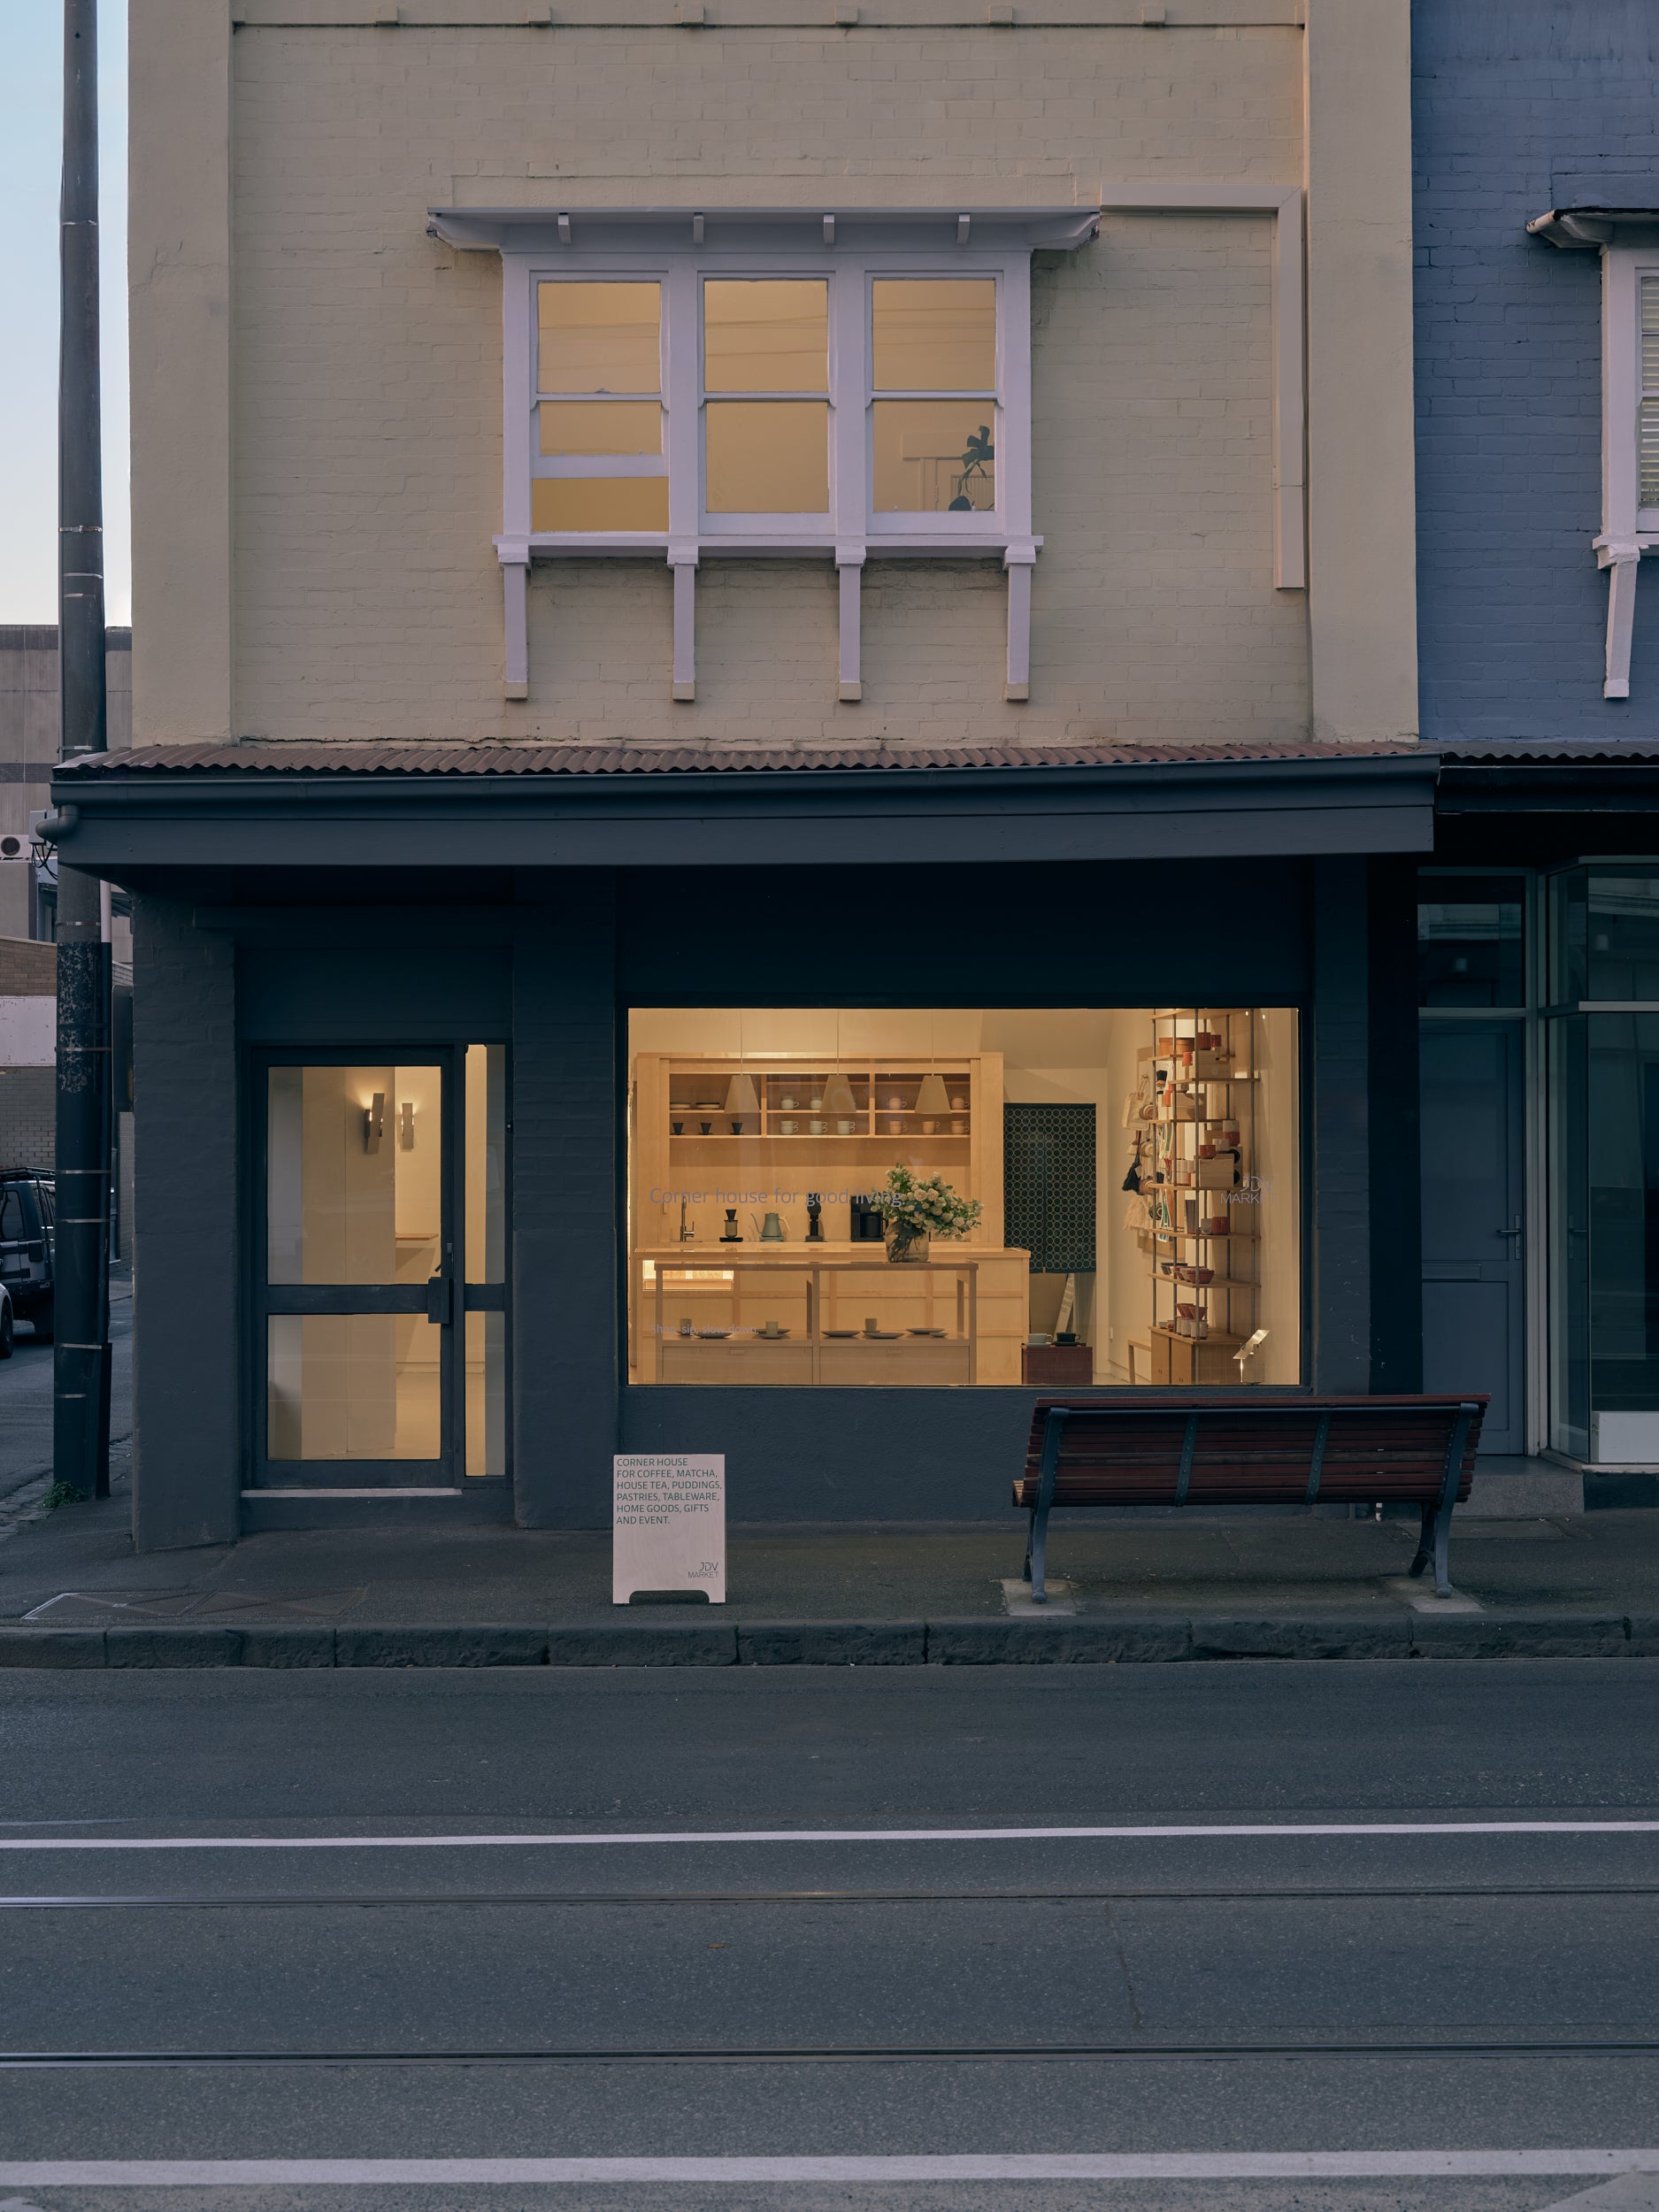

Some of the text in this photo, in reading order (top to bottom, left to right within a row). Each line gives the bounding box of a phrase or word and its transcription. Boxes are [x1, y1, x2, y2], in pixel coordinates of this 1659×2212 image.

[1240, 1176, 1274, 1192] JDV
[650, 1187, 707, 1203] Corner
[716, 1187, 768, 1203] house
[774, 1187, 798, 1203] for
[805, 1188, 849, 1207] good
[617, 1457, 688, 1467] CORNER HOUSE
[617, 1469, 718, 1479] FOR COFFEE, MATCHA,
[617, 1480, 723, 1490] HOUSE TEA, PUDDINGS,
[617, 1492, 720, 1502] PASTRIES, TABLEWARE,
[617, 1503, 710, 1513] HOME GOODS, GIFTS
[616, 1516, 671, 1525] AND EVENT.
[699, 1562, 718, 1571] JDV
